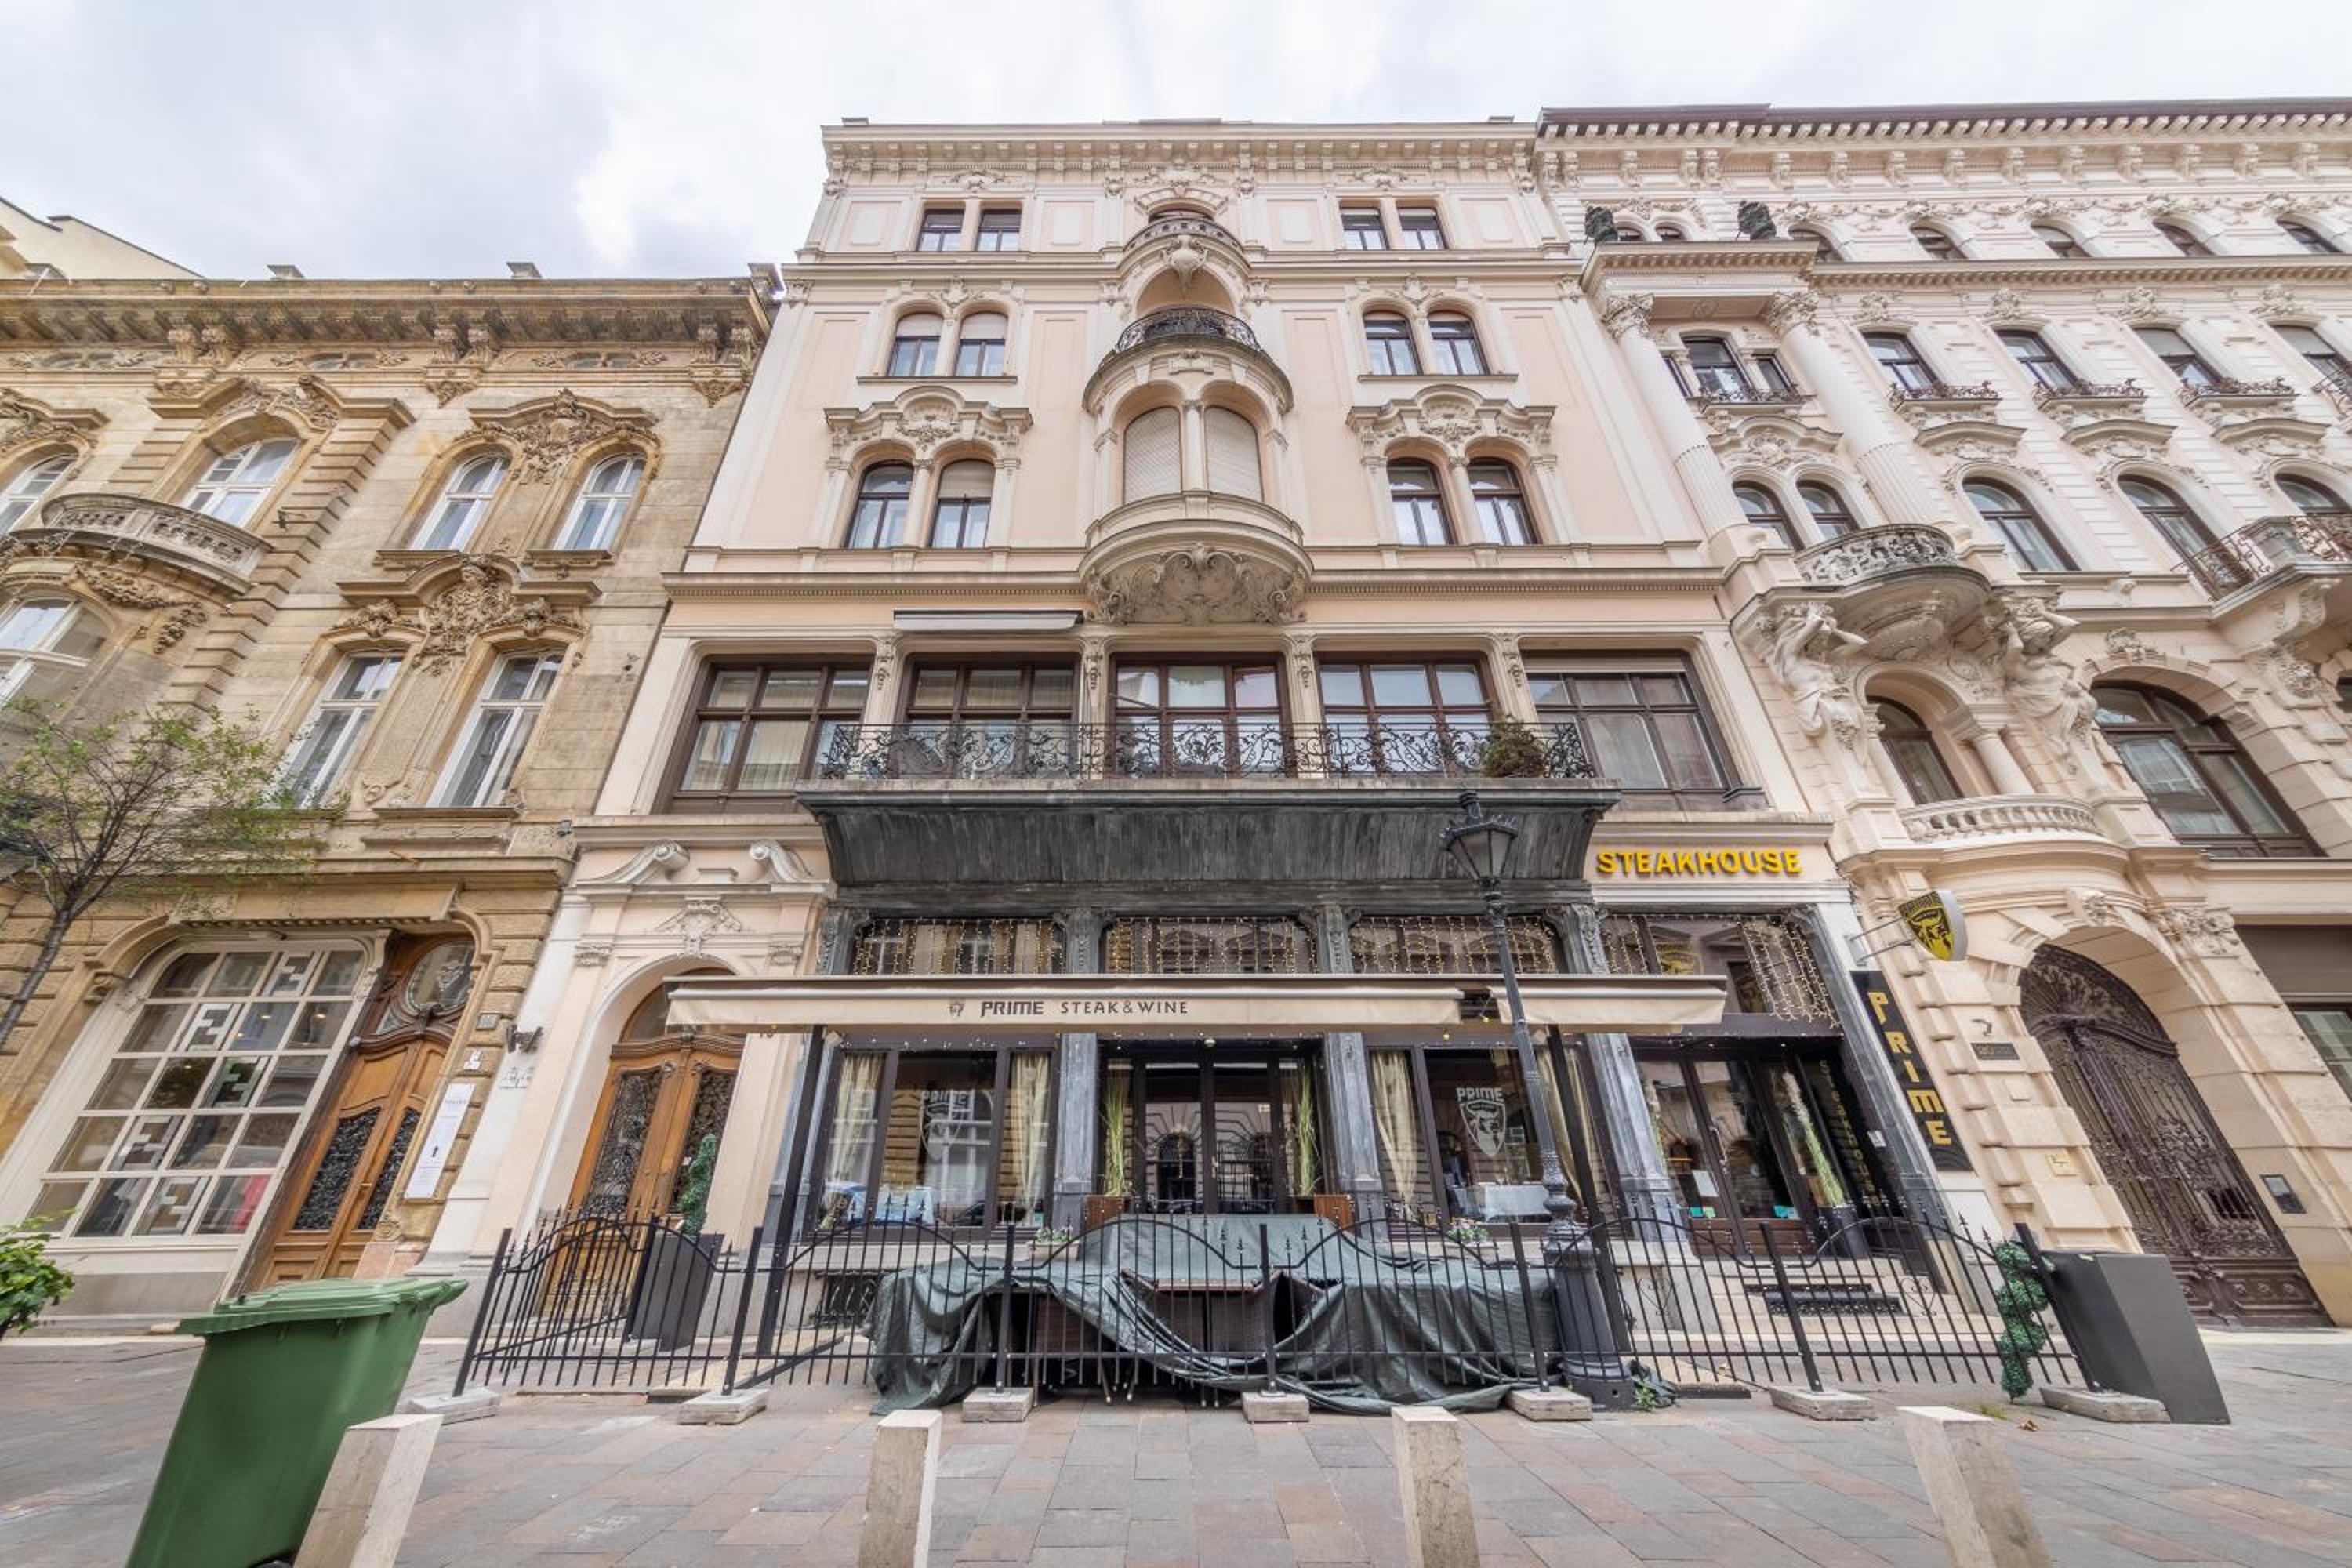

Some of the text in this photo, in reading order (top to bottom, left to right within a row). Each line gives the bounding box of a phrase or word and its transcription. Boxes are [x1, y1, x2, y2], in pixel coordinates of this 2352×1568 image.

[1596, 850, 1802, 875] STEAKHOUSE
[980, 1000, 1044, 1017] PRIME
[1867, 992, 1951, 1145] PRIME
[1456, 1087, 1504, 1102] PRIME
